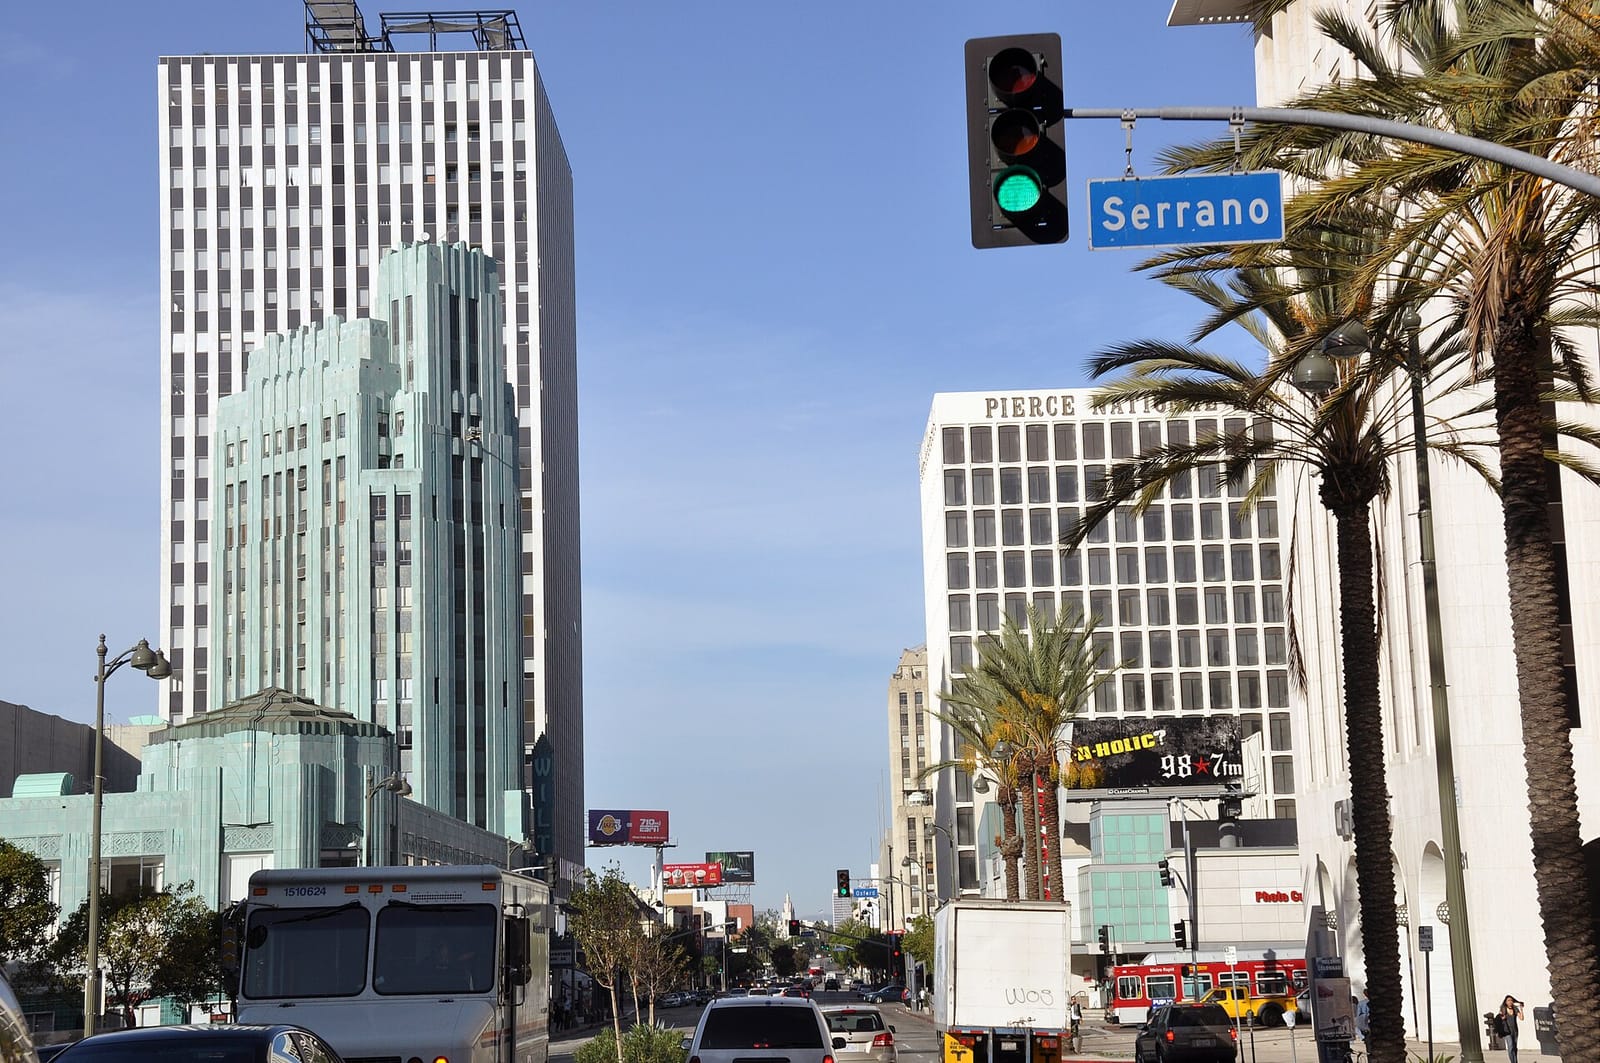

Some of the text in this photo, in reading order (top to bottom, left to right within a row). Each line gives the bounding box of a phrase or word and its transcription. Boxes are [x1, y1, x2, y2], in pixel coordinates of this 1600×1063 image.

[1103, 196, 1269, 231] Serrano
[985, 396, 1075, 418] PIERCE
[284, 887, 327, 896] 1510624
[1255, 891, 1289, 903] Photo
